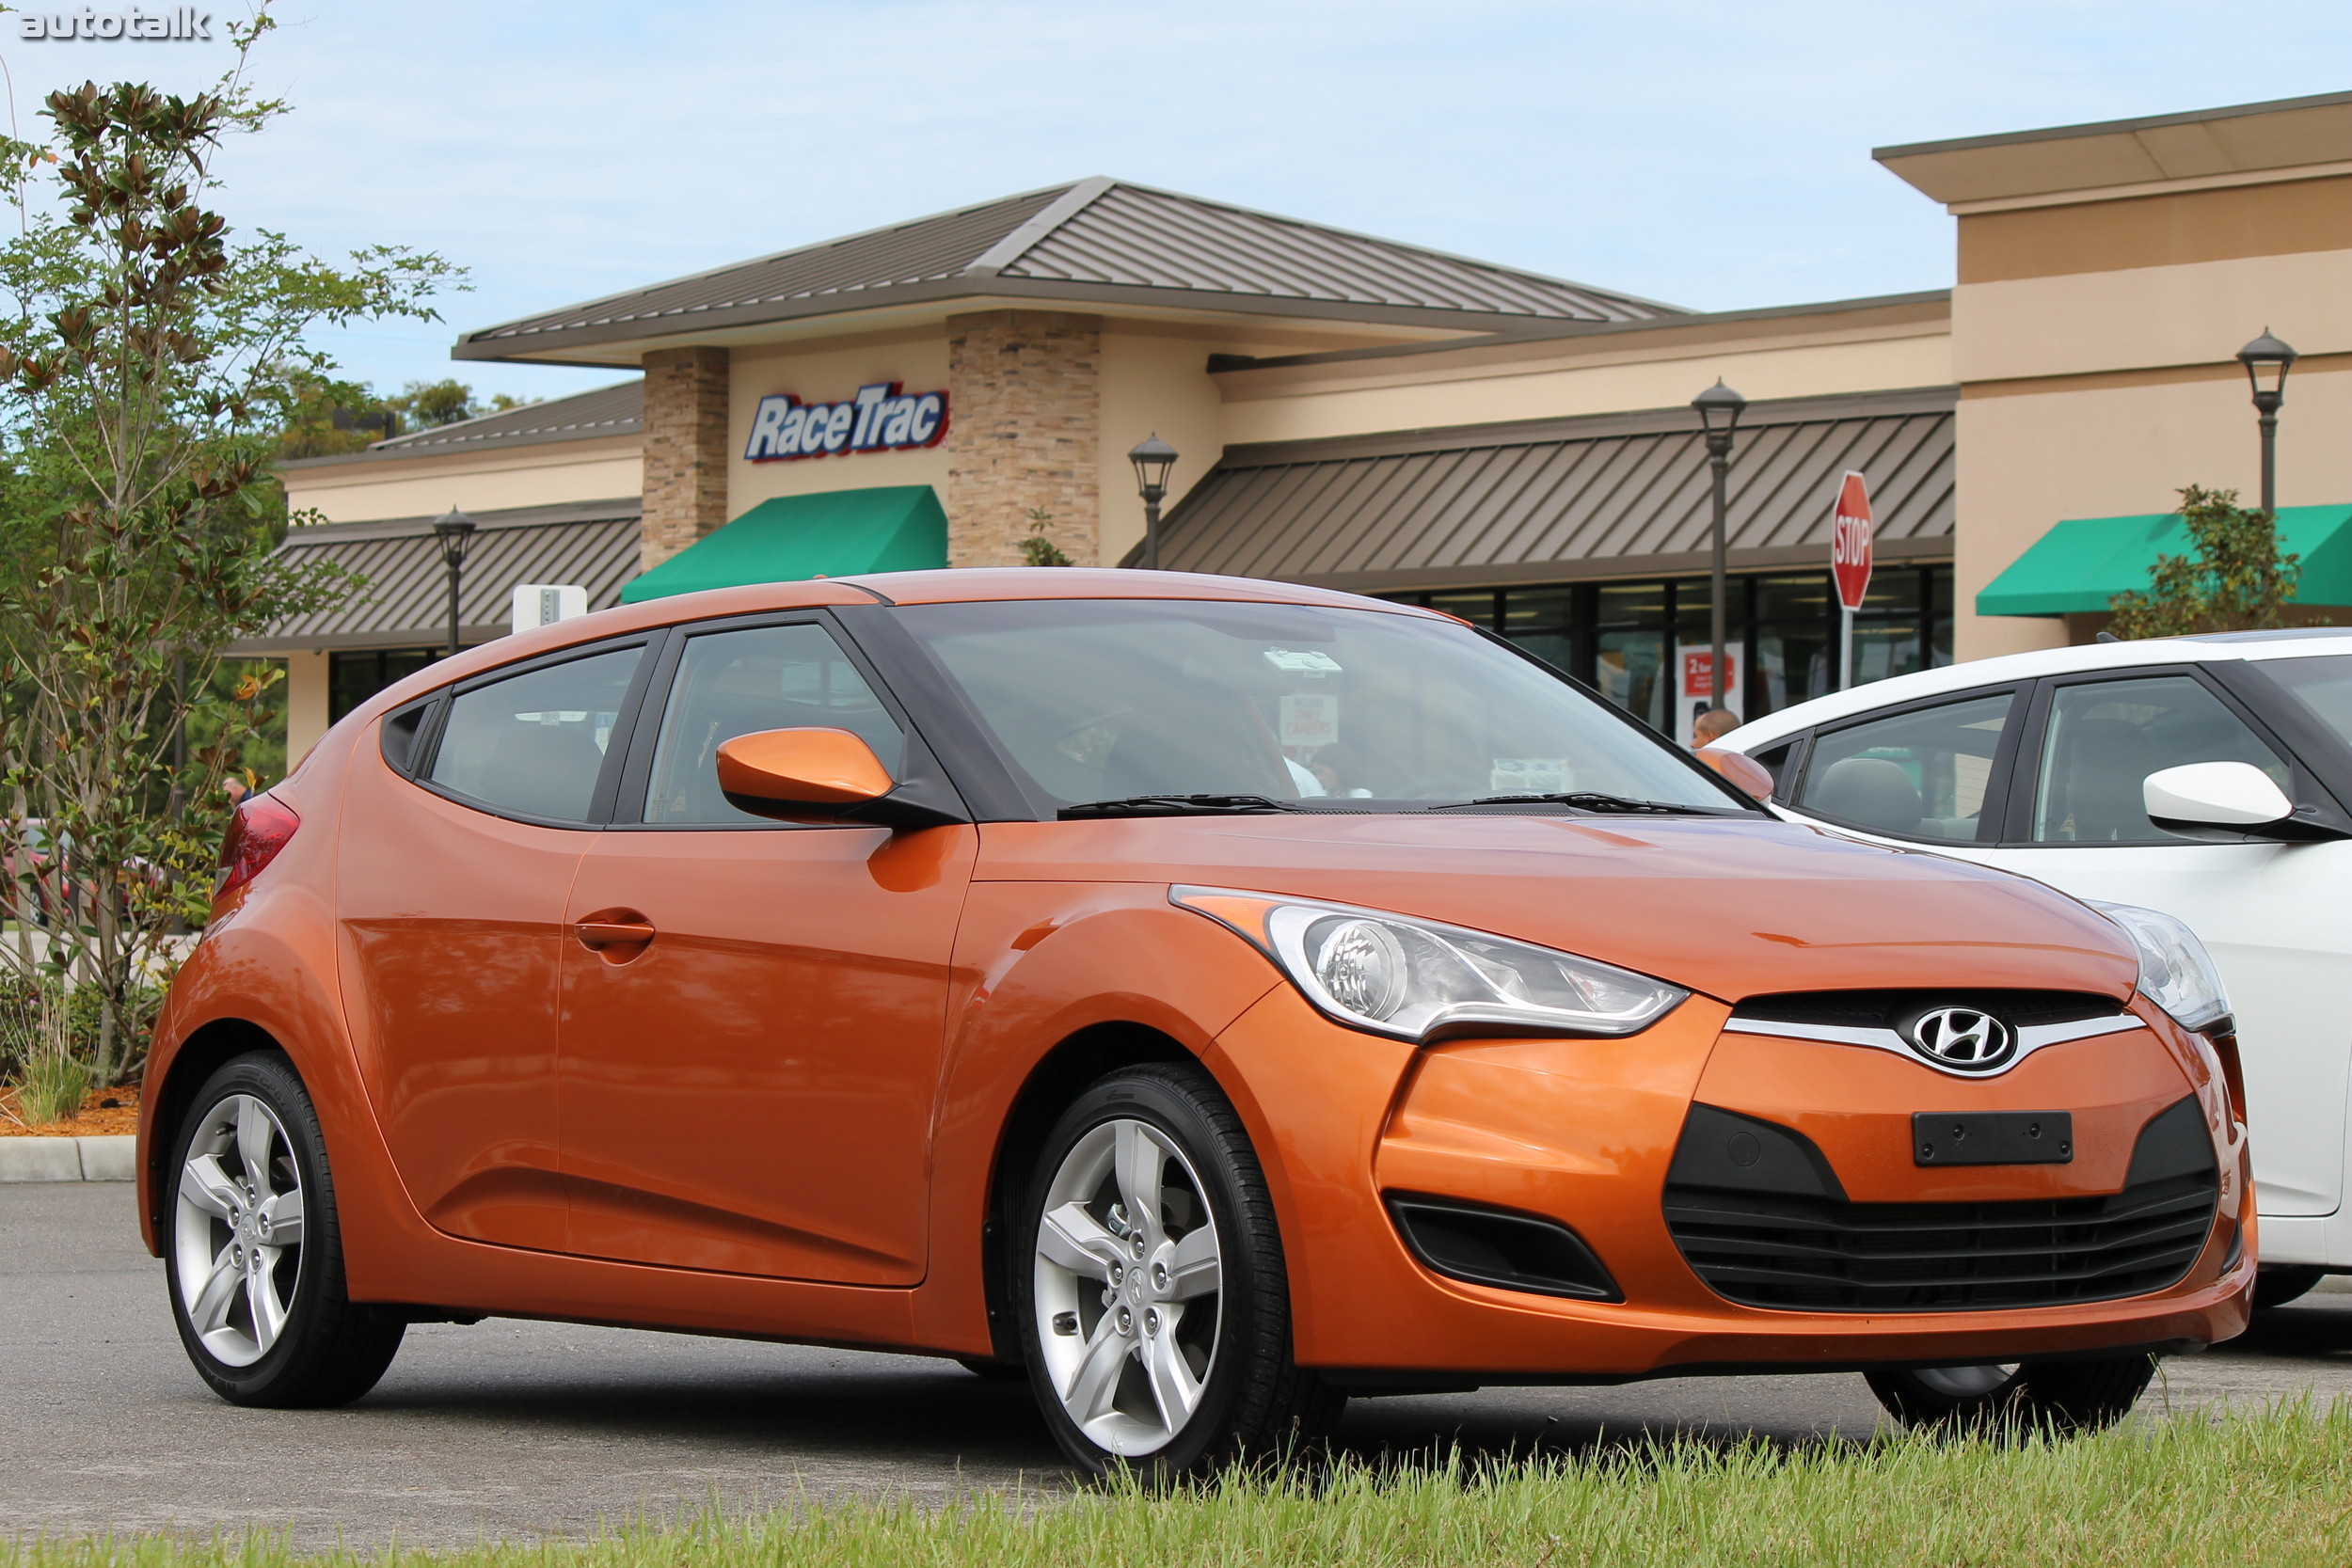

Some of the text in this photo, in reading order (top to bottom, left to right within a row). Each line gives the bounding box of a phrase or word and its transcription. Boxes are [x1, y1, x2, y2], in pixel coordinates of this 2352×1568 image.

[744, 381, 948, 462] RaceTrac
[1836, 515, 1870, 566] STOP
[1689, 658, 1712, 674] 2 for
